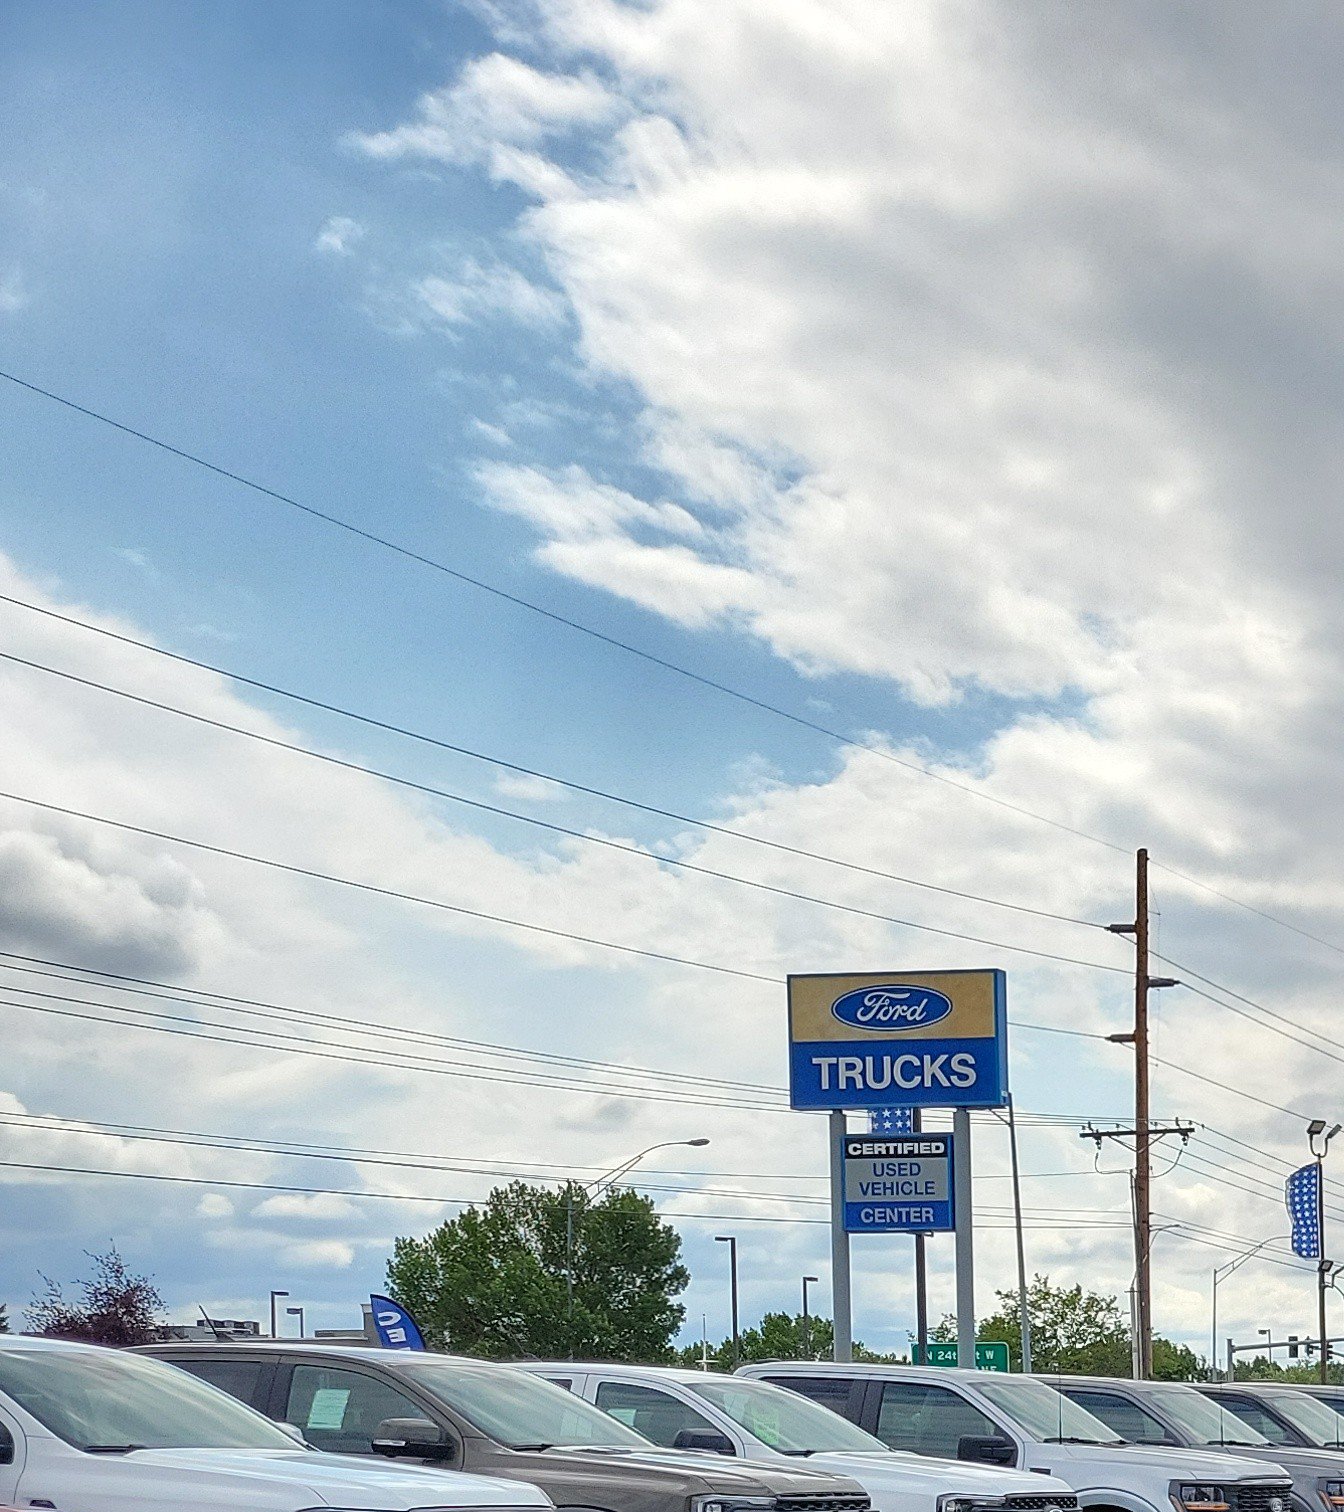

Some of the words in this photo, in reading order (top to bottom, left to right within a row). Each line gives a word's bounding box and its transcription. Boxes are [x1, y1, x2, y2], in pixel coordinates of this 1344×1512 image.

[857, 991, 929, 1022] Ford
[812, 1053, 977, 1090] TRUCKS
[847, 1141, 945, 1155] CERTIFIED
[872, 1162, 922, 1177] USED
[859, 1181, 936, 1196] VEHICLE
[860, 1206, 934, 1223] CENTER
[985, 1350, 994, 1360] W
